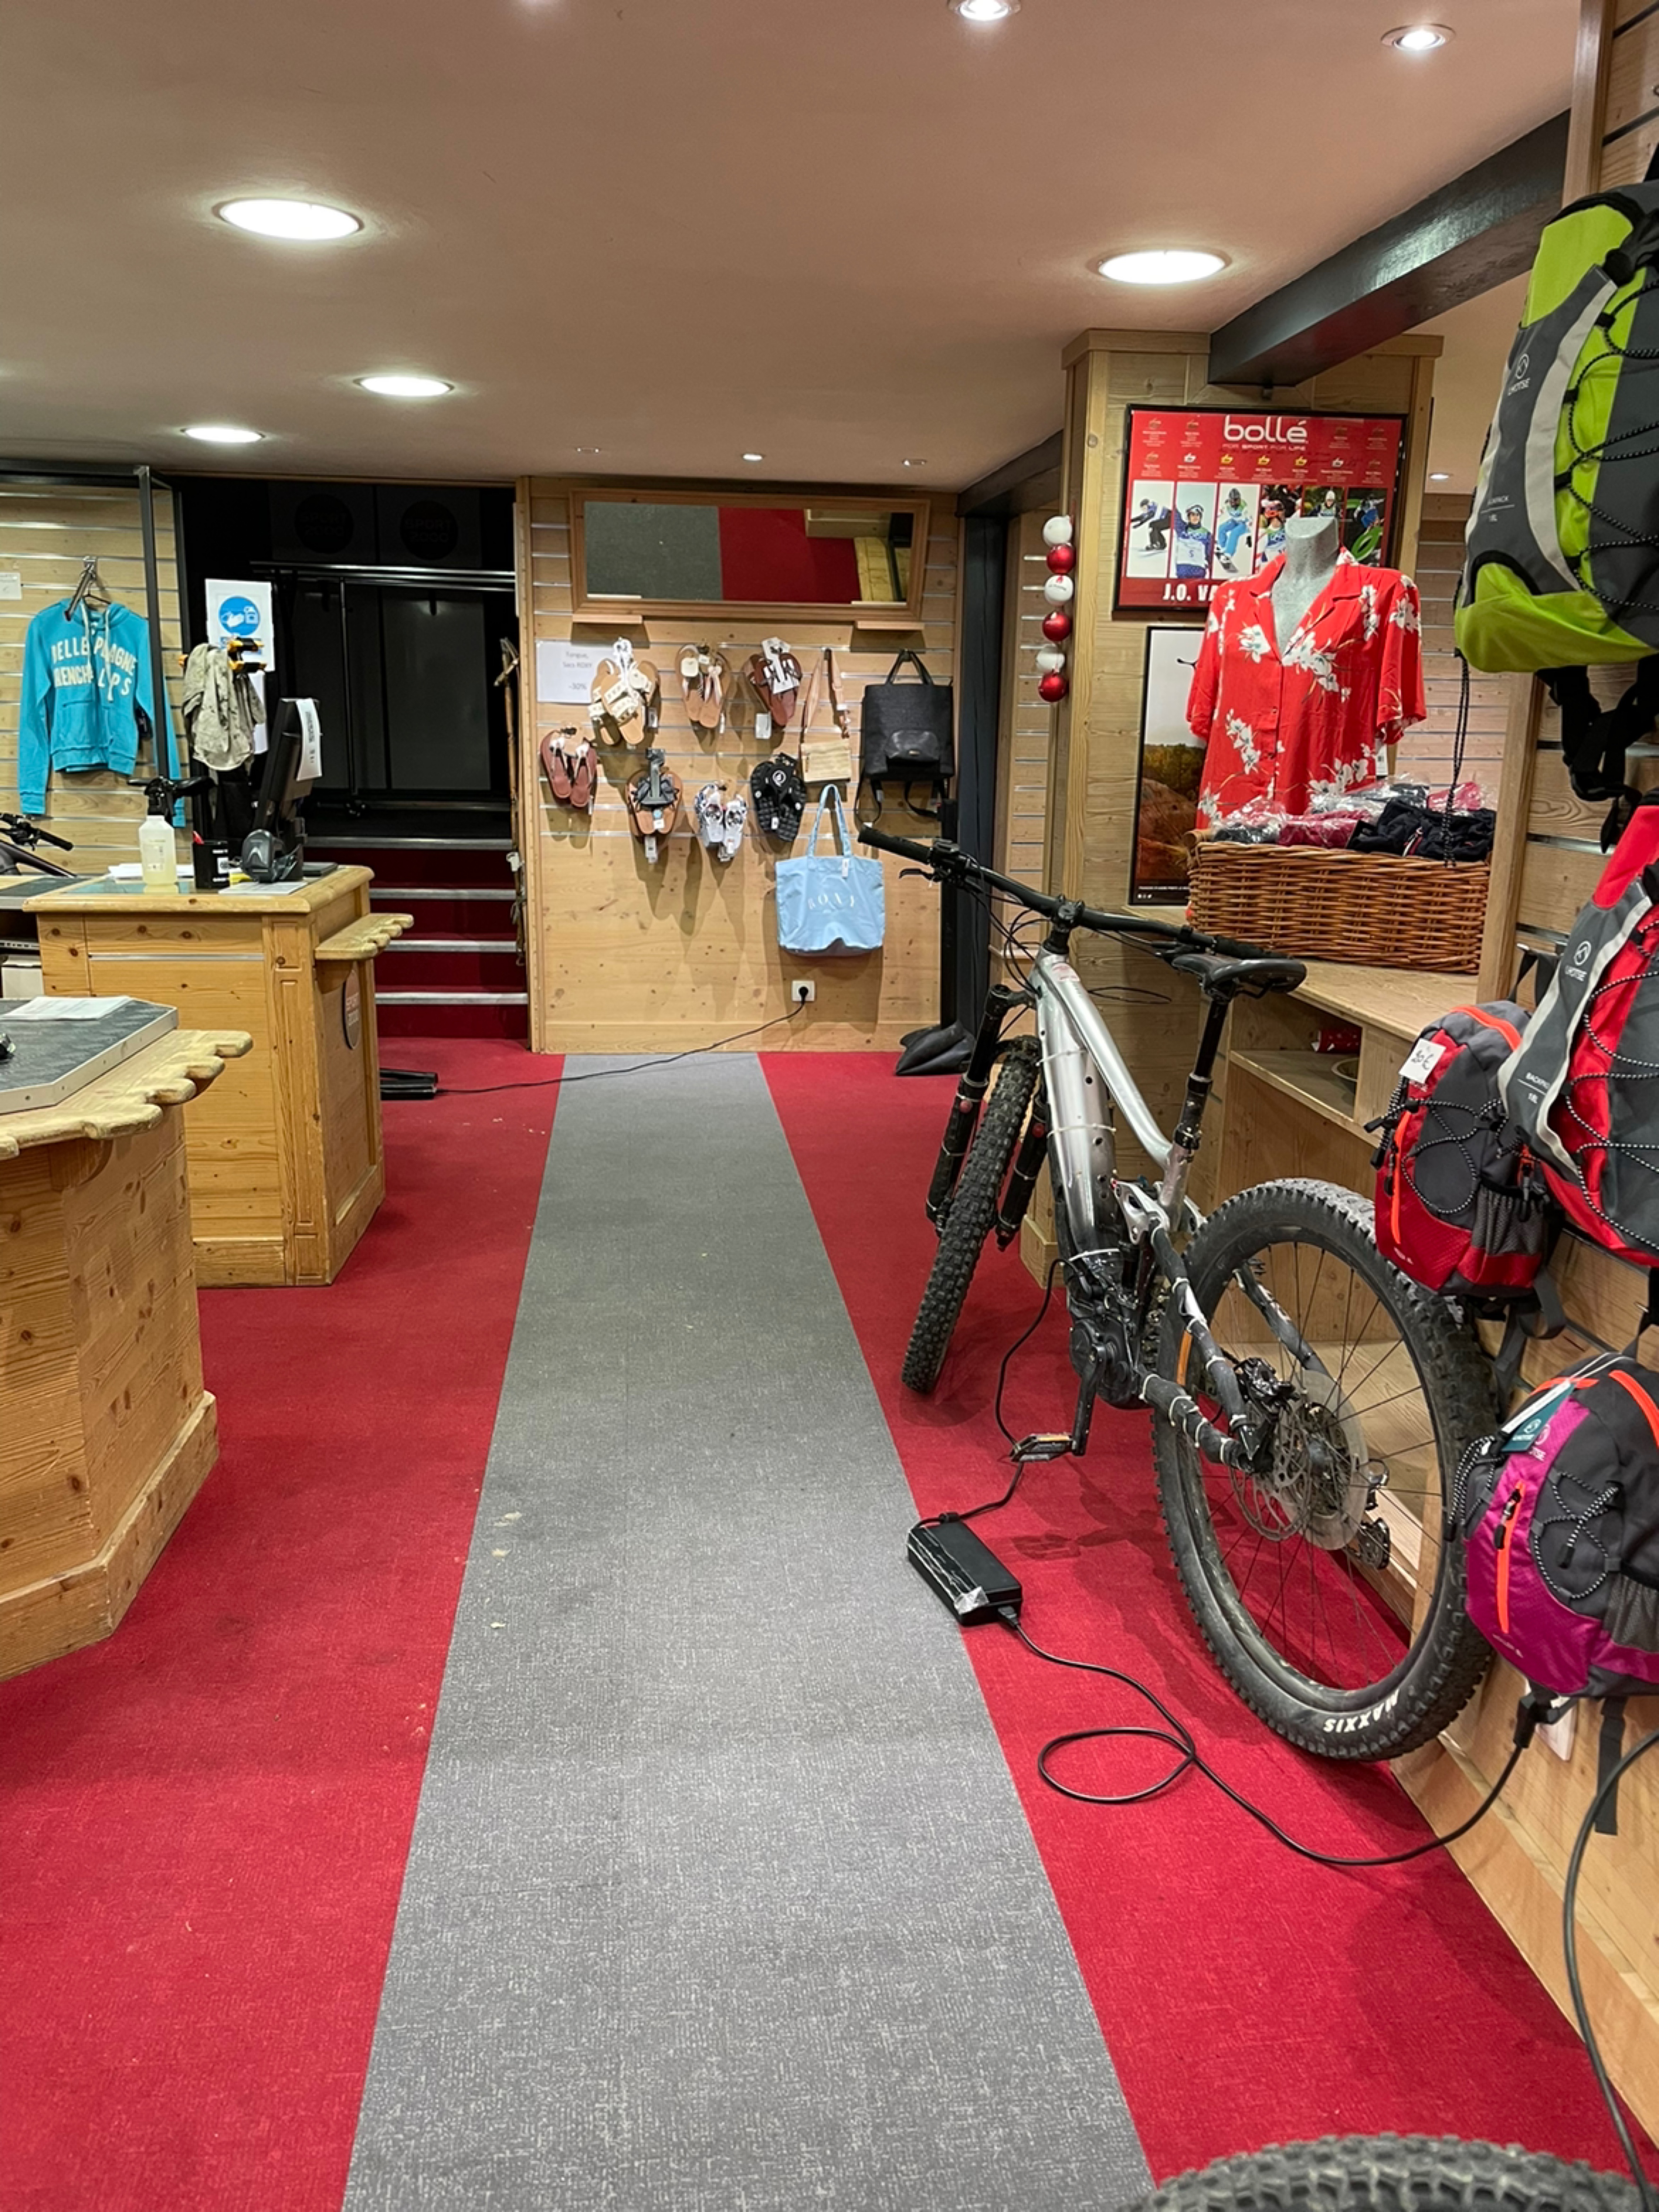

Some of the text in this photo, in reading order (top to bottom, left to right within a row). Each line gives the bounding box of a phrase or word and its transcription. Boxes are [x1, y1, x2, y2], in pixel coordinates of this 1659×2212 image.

[1224, 415, 1308, 443] bollé
[1163, 583, 1191, 601] J.O.
[1323, 1688, 1399, 1733] MAXXIS
